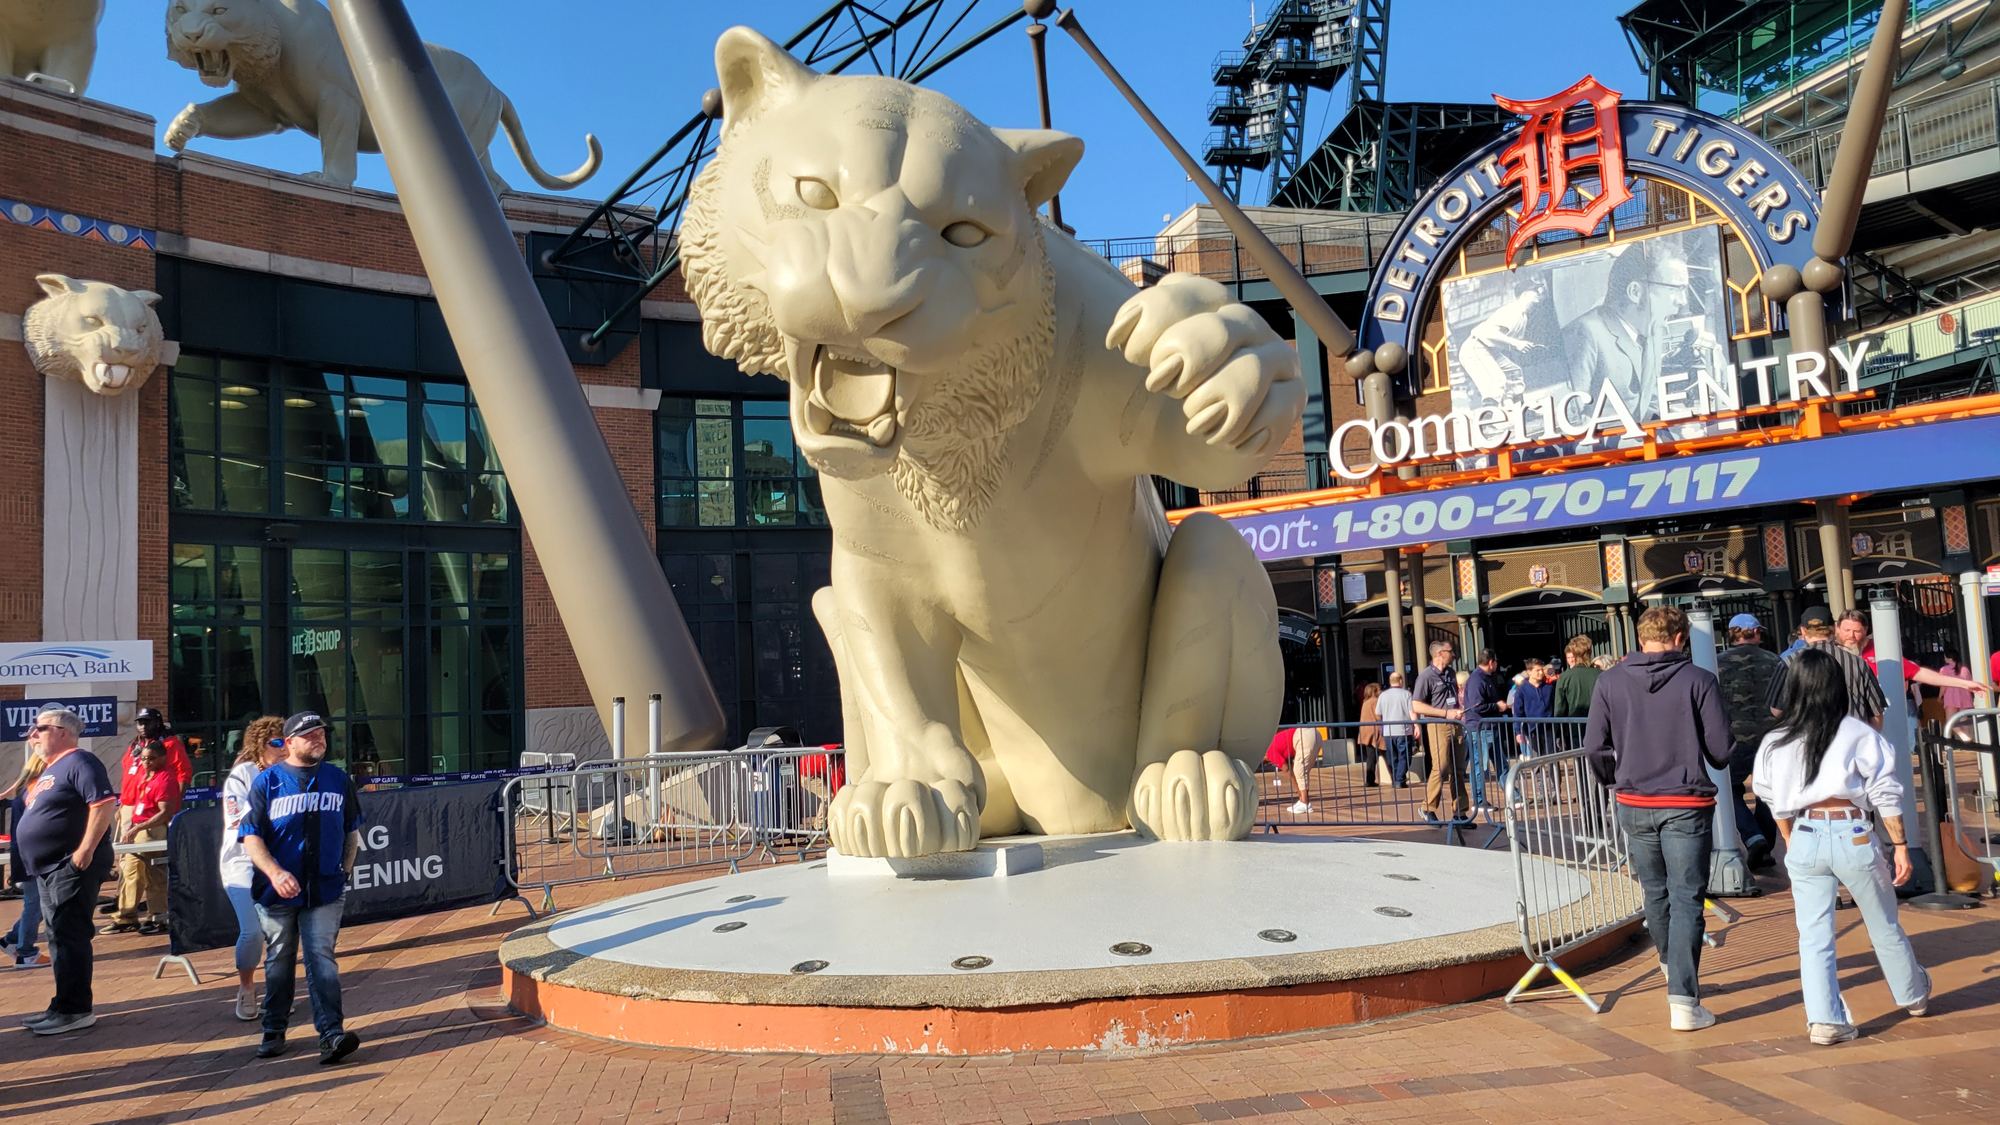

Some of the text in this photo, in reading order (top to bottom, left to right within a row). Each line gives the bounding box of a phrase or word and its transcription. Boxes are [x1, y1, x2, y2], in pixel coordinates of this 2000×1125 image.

[1373, 152, 1502, 322] DETROIT
[1646, 118, 1809, 242] TIGERS
[1657, 341, 1871, 422] ENTRY
[1332, 457, 1761, 544] 1-800-270-7117
[316, 629, 341, 652] SHOP
[84, 659, 133, 674] Bank
[5, 706, 40, 728] VIP
[269, 791, 344, 821] MOTOR CITY
[344, 854, 444, 891] ENING
